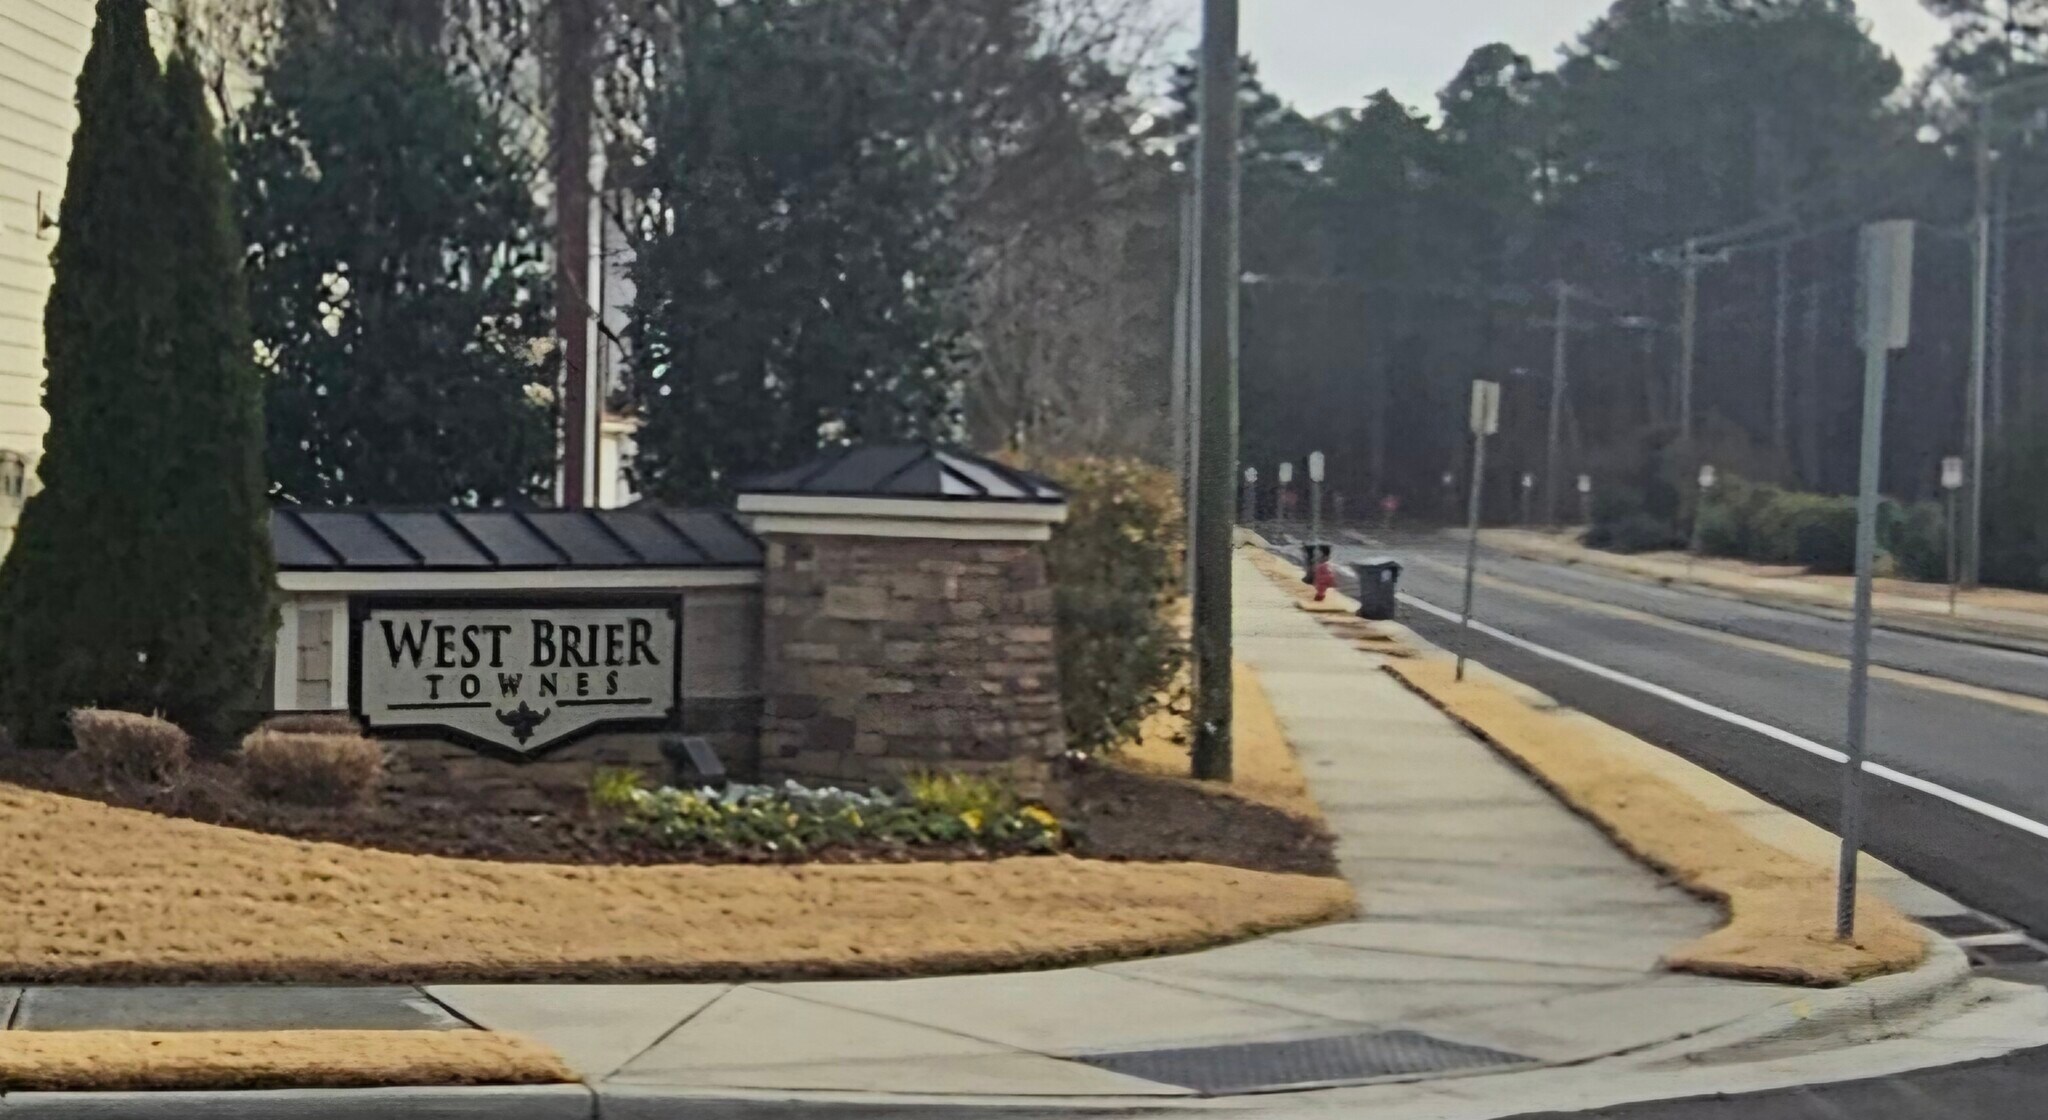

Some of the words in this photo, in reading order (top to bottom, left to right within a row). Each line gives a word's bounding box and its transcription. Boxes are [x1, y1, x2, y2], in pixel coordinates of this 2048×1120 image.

[380, 618, 512, 669] WEST
[529, 617, 661, 668] BRIER
[425, 670, 619, 700] TOWNES
